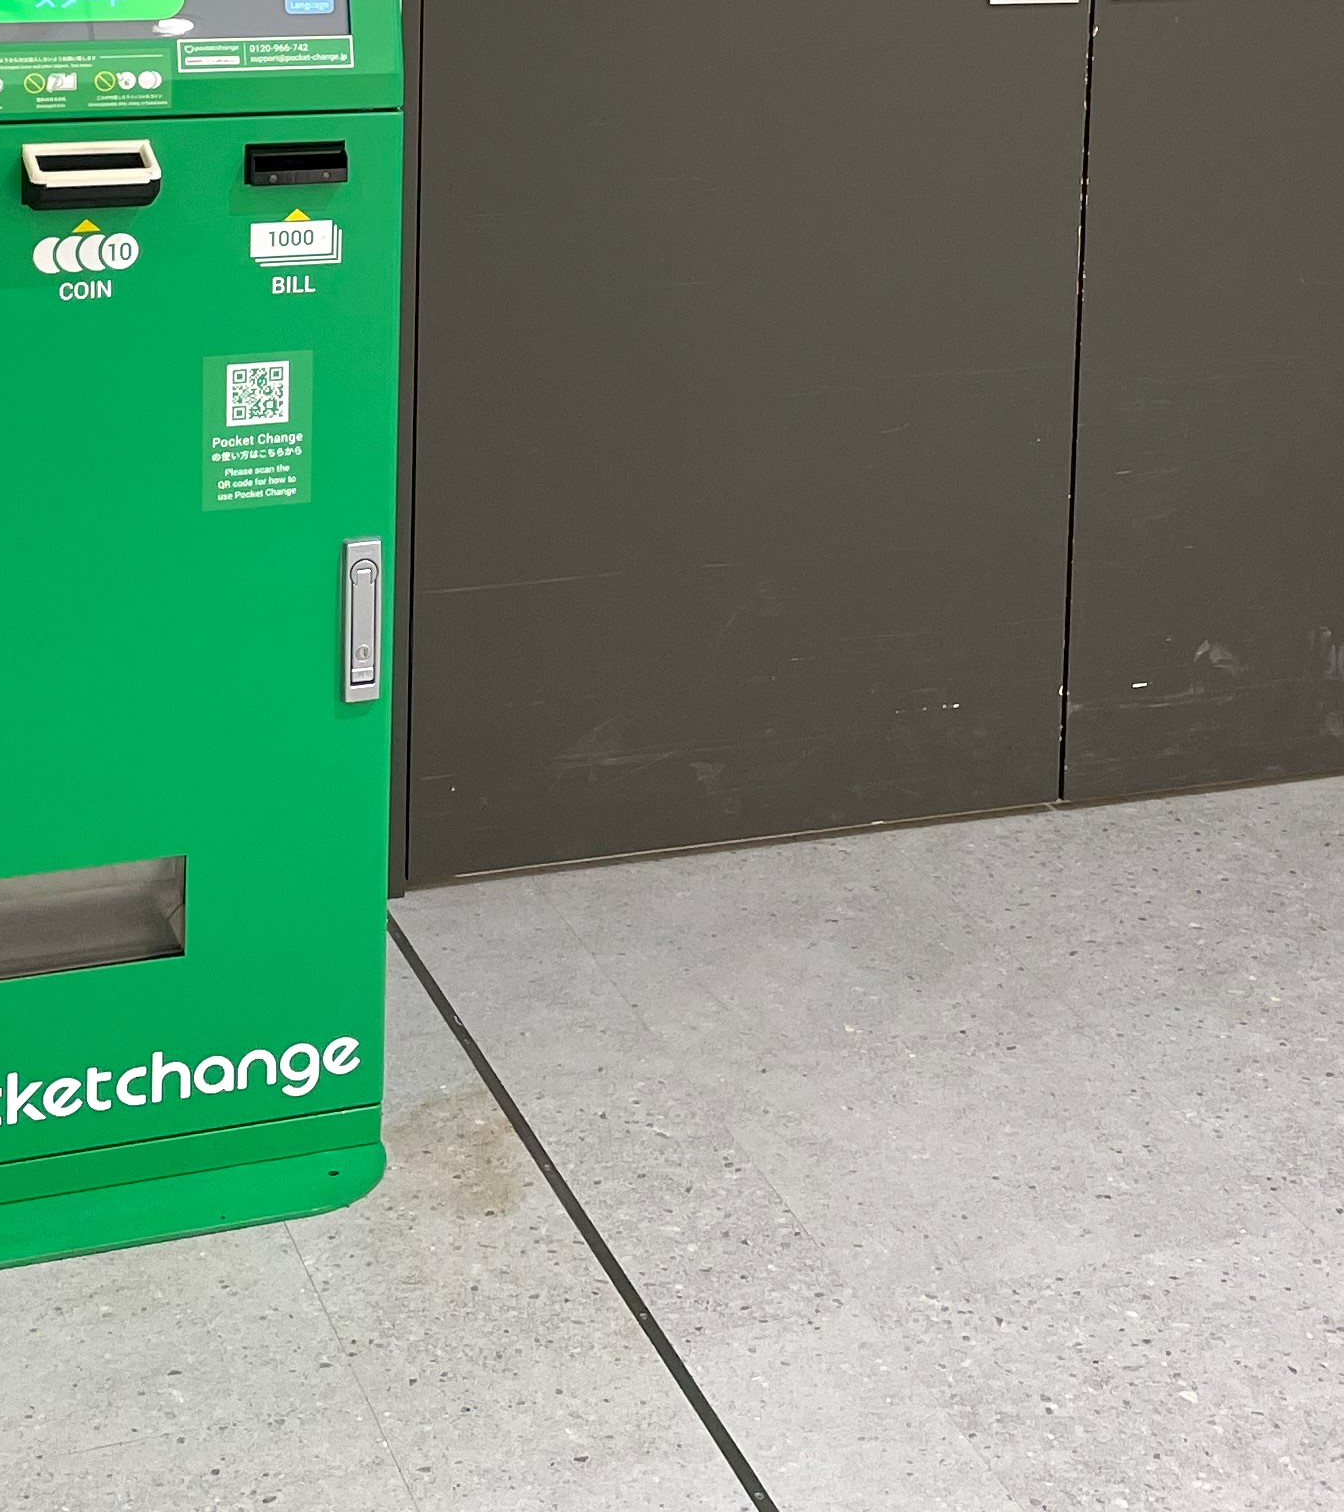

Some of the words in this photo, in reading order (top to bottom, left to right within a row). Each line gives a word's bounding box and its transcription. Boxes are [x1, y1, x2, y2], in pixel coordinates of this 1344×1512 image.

[290, 1, 329, 11] Language
[249, 43, 309, 53] 0120-966-742
[250, 53, 348, 63] support@pocket-change.jp
[268, 229, 315, 248] 1000
[108, 241, 132, 262] 10
[58, 280, 112, 301] COIN
[271, 275, 316, 295] BILL
[212, 435, 254, 448] Pocket
[258, 432, 303, 445] Change
[211, 445, 302, 462] の使い方はこちらから
[225, 468, 253, 477] Please
[255, 466, 275, 475] scan
[276, 464, 290, 472] the
[218, 480, 231, 489] QR
[232, 479, 253, 488] code
[255, 477, 267, 486] for
[268, 476, 286, 485] how
[288, 475, 297, 483] to
[218, 493, 233, 501] use
[235, 490, 264, 499] Pocket
[265, 488, 297, 497] Change
